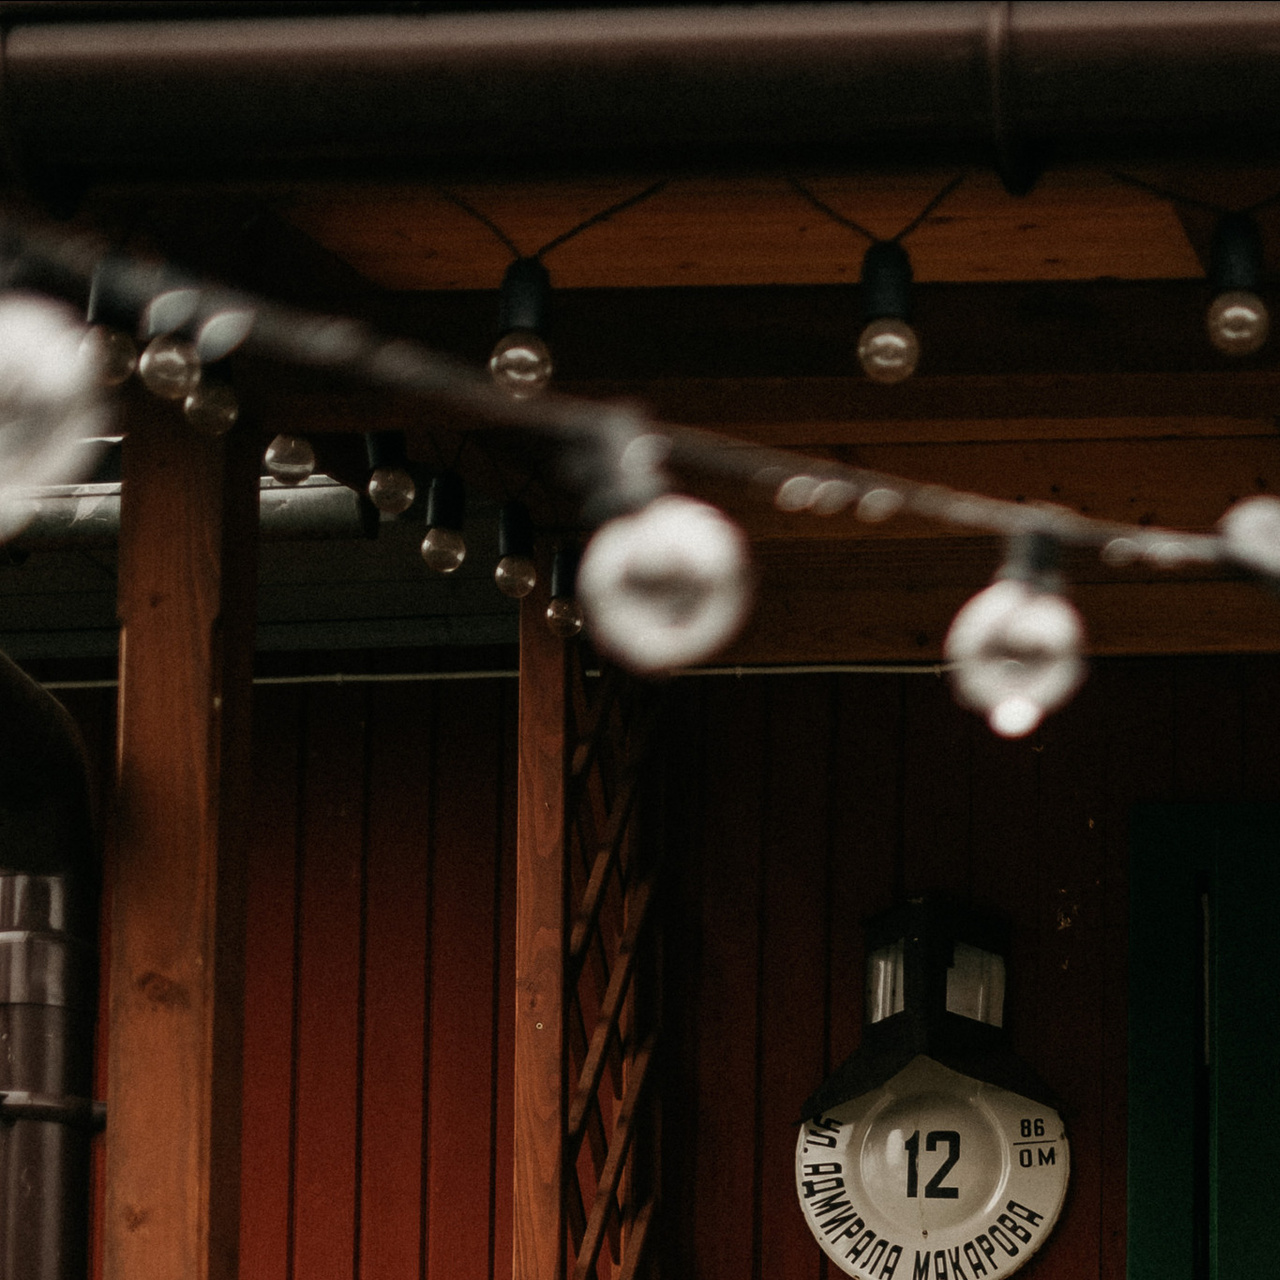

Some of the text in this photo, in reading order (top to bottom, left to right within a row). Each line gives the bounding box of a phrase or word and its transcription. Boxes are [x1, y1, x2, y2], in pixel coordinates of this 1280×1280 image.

[803, 1113, 843, 1153] УЛ.
[1020, 1118, 1045, 1137] 86
[905, 1130, 961, 1199] 12
